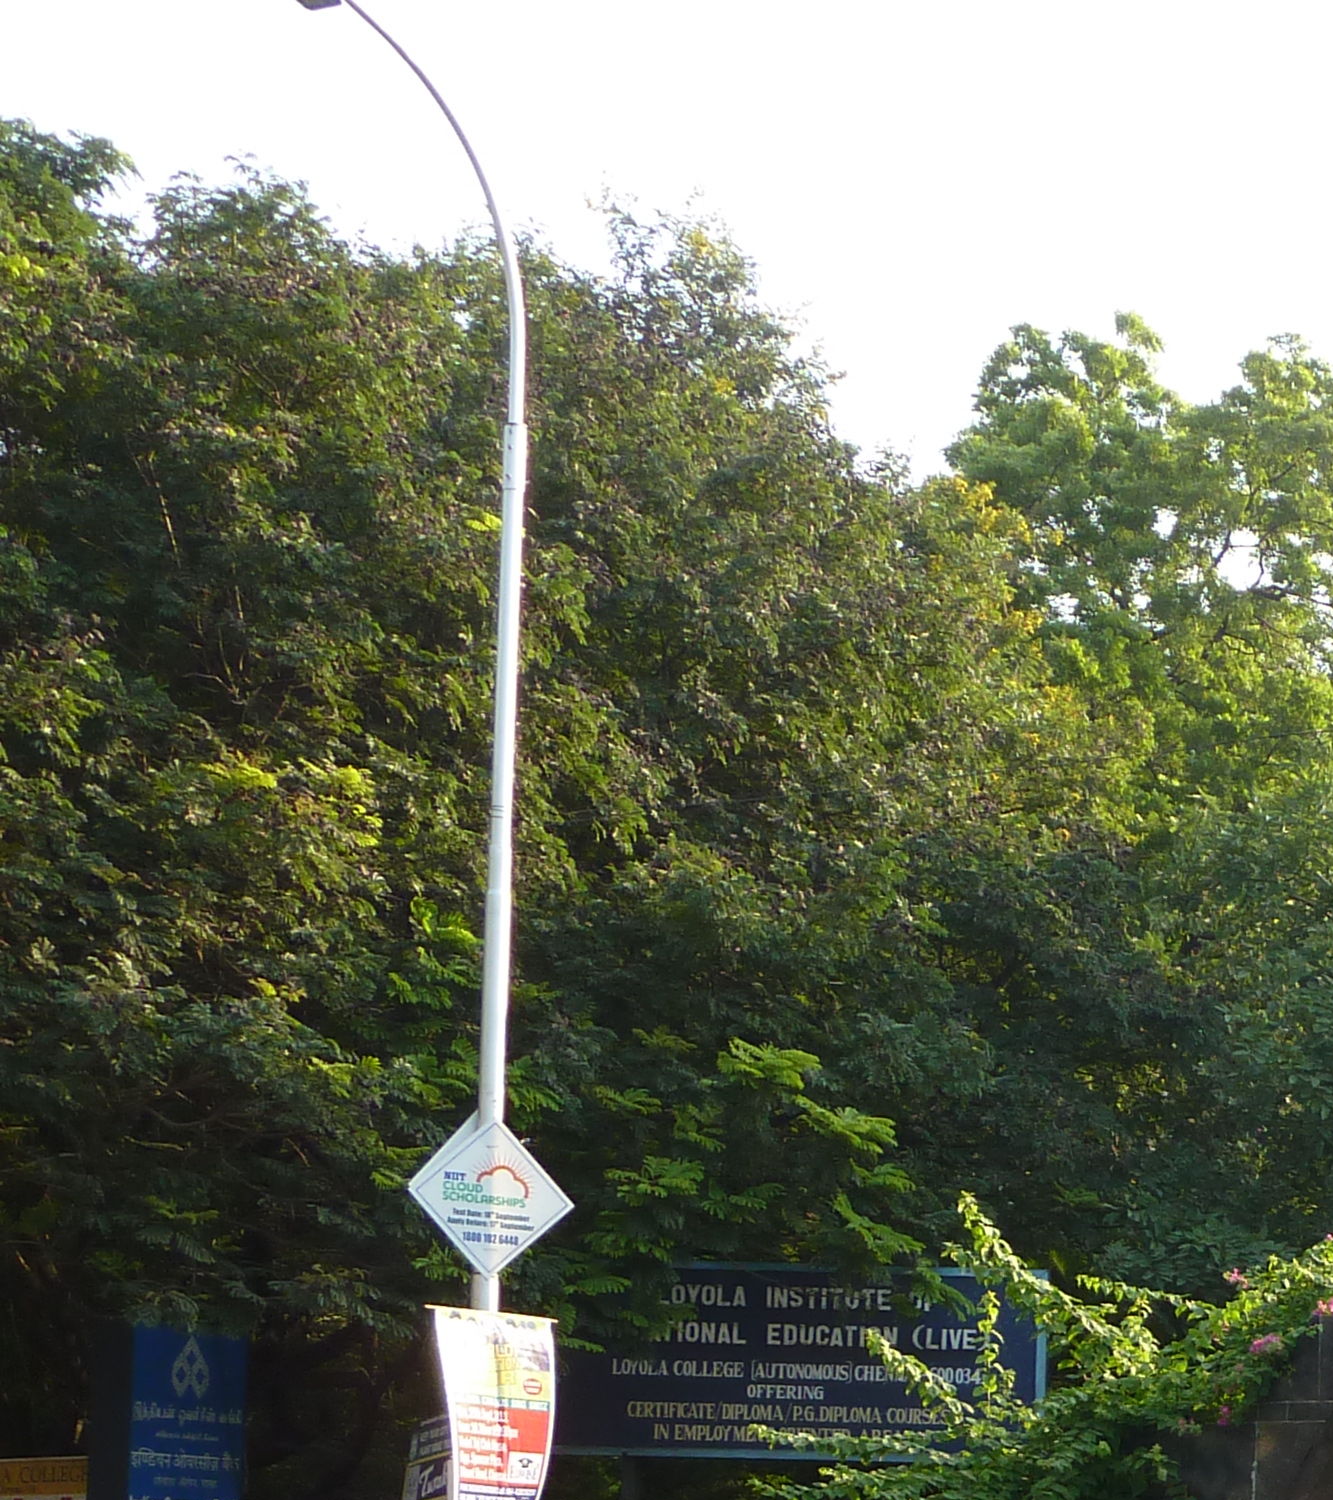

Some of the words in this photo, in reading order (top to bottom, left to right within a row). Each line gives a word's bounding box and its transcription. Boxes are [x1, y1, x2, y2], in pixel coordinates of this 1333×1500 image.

[443, 1171, 466, 1181] NIIT
[442, 1180, 483, 1193] CLOUD
[442, 1191, 526, 1208] SCHOLARSHIPS
[495, 1212, 530, 1222] September
[500, 1222, 535, 1231] September
[660, 1283, 747, 1307] OYOLA
[766, 1286, 892, 1311] INSTITUTE
[767, 1323, 898, 1348] EDUCATIN
[612, 1358, 669, 1376] LOYOLA
[672, 1360, 744, 1378] COLLEGE
[746, 1384, 825, 1400] OFFERING
[653, 1423, 670, 1440] IN
